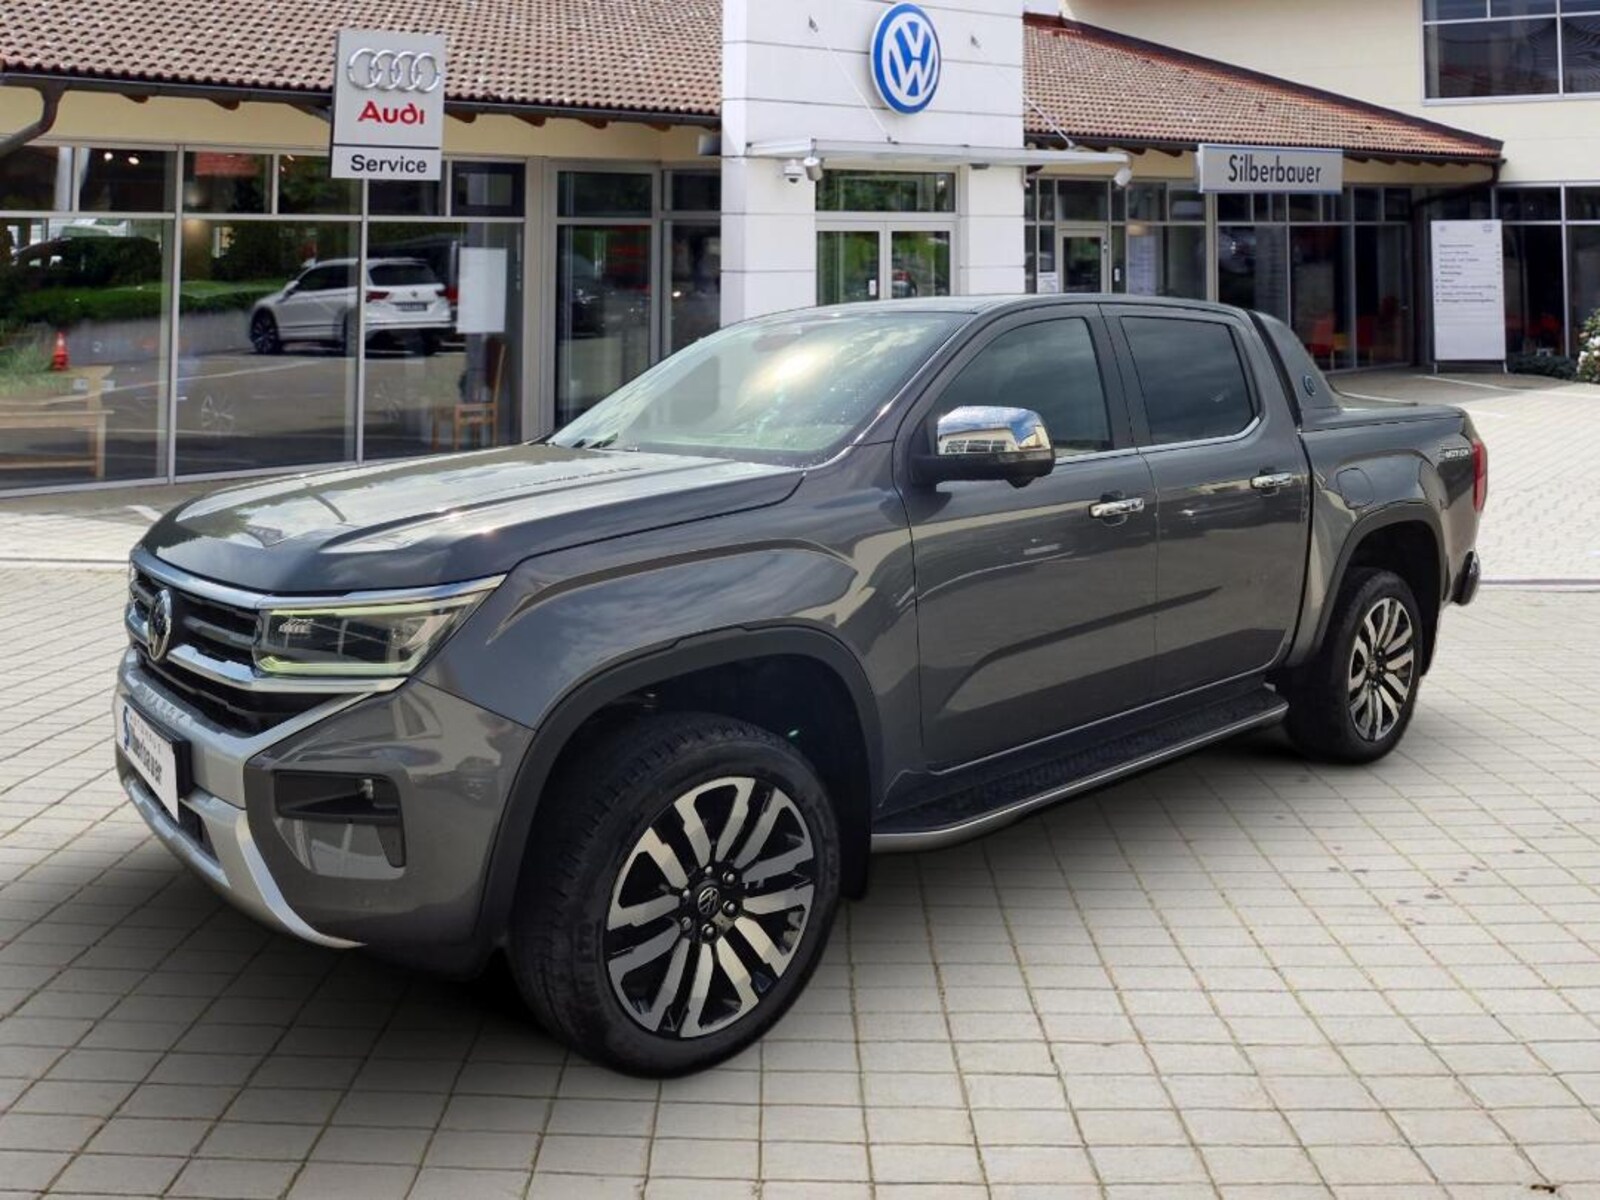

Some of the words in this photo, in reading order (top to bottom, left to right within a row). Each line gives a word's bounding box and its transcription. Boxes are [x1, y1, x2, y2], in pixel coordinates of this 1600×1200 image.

[358, 101, 425, 125] Audi
[350, 154, 427, 173] Service
[1228, 154, 1321, 183] Silberbauer
